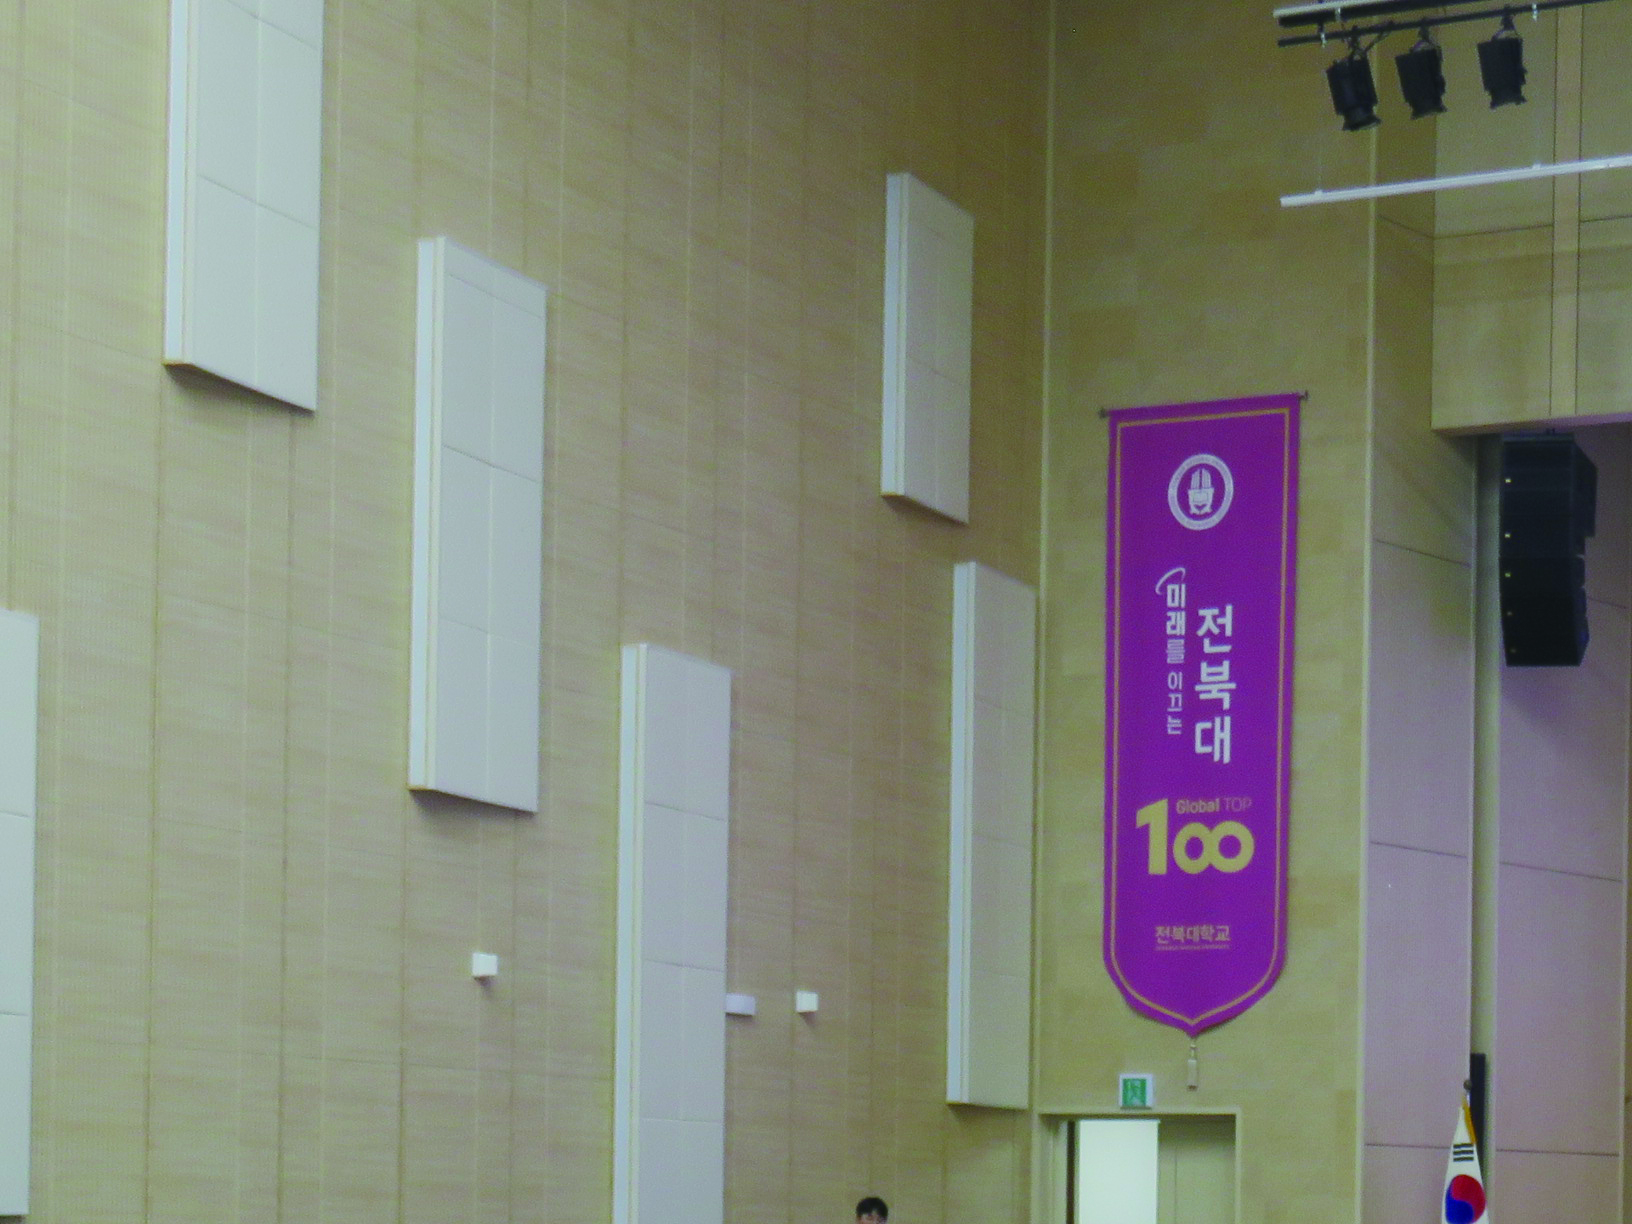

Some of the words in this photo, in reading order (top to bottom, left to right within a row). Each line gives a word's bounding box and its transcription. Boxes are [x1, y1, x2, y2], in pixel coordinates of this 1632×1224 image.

[1165, 582, 1186, 664] 미래를
[1166, 671, 1184, 735] 이끄는
[1194, 604, 1237, 764] 전북대
[1136, 798, 1255, 876] 100
[1175, 798, 1220, 815] Global
[1224, 796, 1252, 813] TOP
[1154, 924, 1231, 945] 전북대학교
